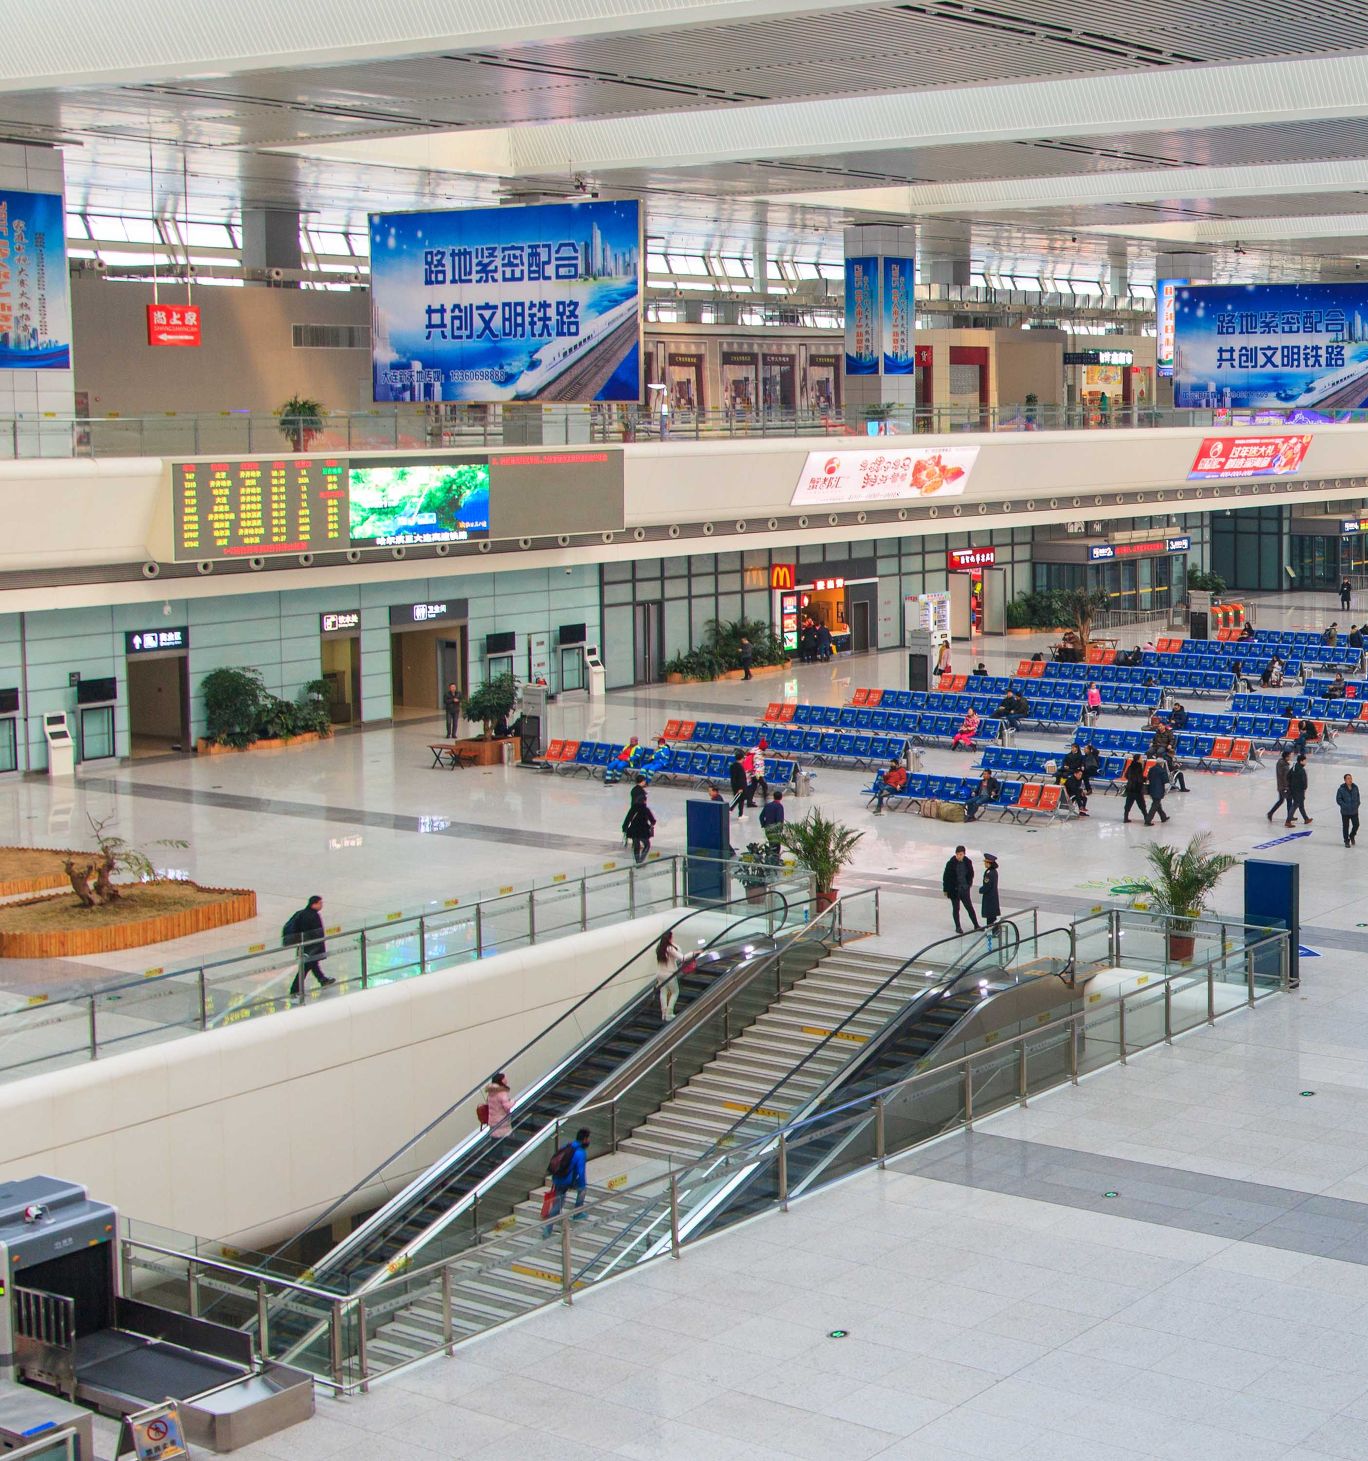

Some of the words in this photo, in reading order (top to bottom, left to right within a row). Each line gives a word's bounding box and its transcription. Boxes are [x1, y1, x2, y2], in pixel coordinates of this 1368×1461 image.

[424, 241, 580, 286] 路地紧密配合
[425, 300, 580, 341] 共创文明铁路
[1216, 308, 1345, 336] 路地紧密配合
[1216, 344, 1345, 369] 共创文明铁路
